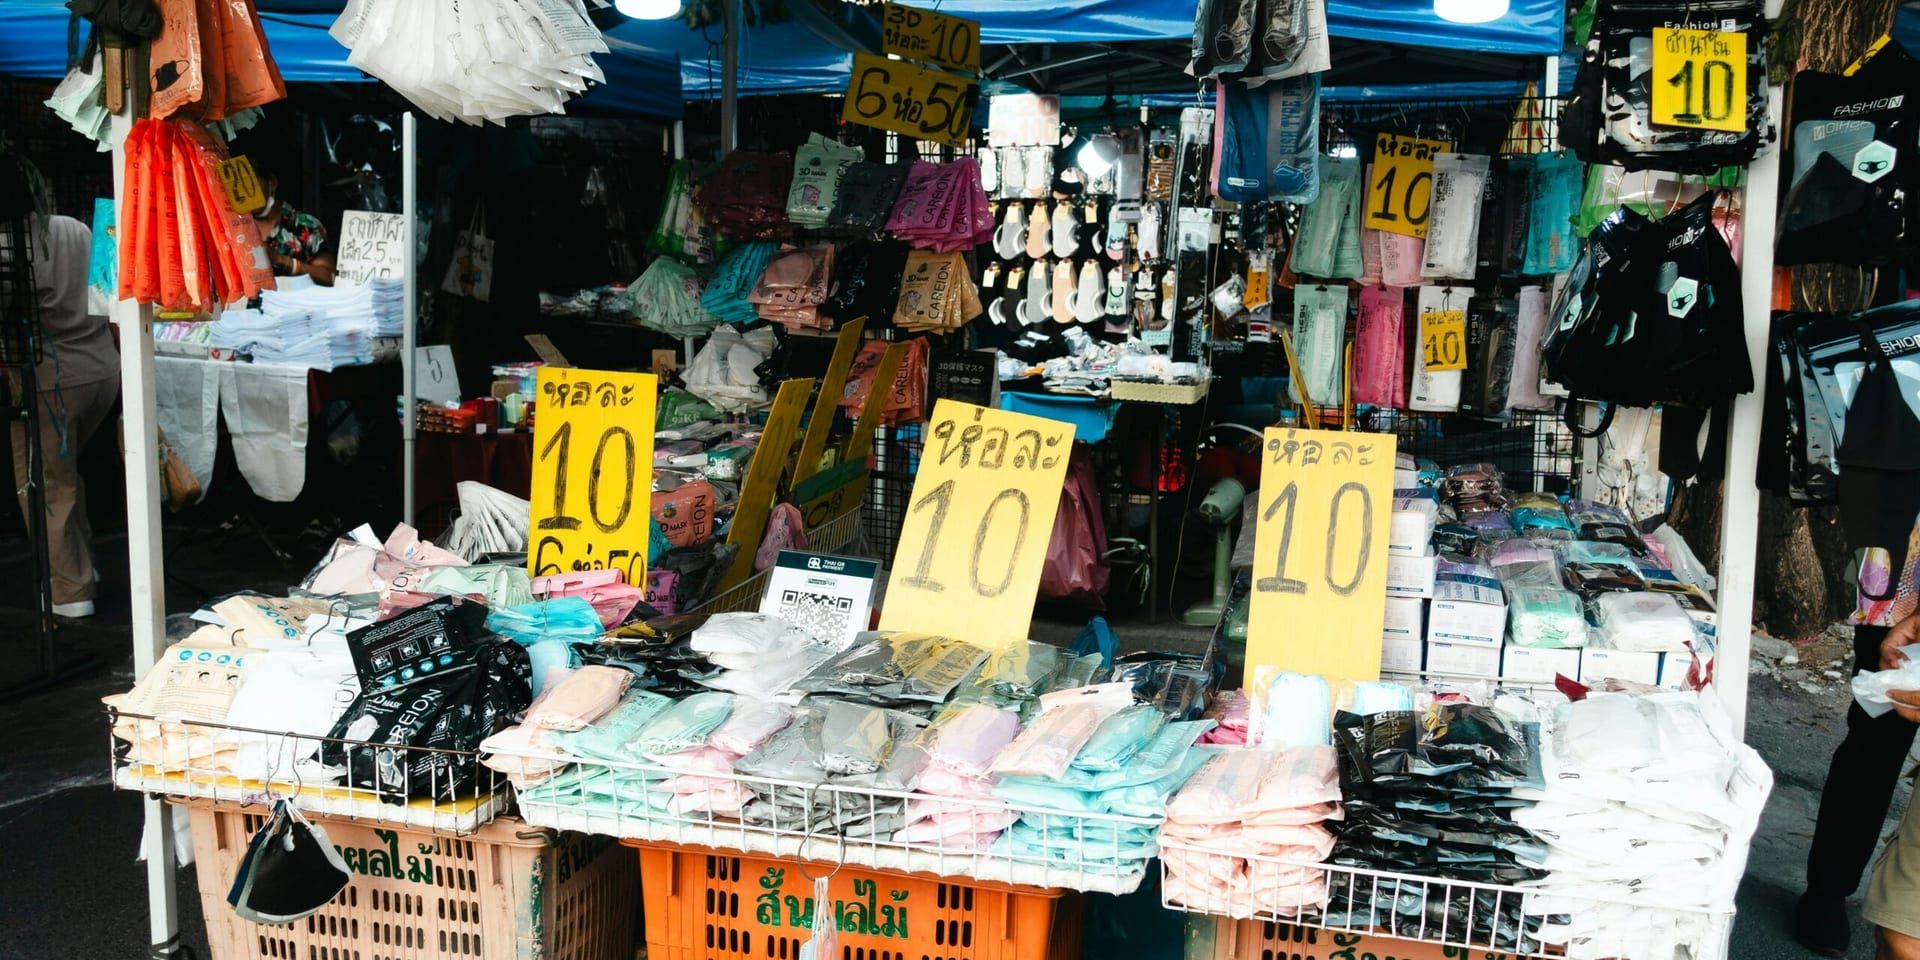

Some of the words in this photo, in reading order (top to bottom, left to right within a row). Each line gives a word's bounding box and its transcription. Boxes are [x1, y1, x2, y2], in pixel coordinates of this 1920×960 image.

[888, 6, 922, 28] 3D
[929, 17, 971, 66] 10
[855, 67, 891, 119] 6
[920, 82, 973, 139] 50
[1667, 60, 1734, 125] 10
[1833, 95, 1904, 116] FASHION
[223, 159, 255, 202] 20
[923, 172, 952, 224] CAREION
[1371, 166, 1432, 226] 10
[362, 241, 388, 263] 25
[928, 261, 951, 320] CAREION
[1425, 331, 1460, 366] 10
[1879, 335, 1920, 354] SHIO
[543, 370, 635, 409] ห่อละ
[935, 408, 1063, 472] ห่อละ
[1267, 428, 1375, 467] ห่อละ
[538, 421, 635, 534] 10
[900, 479, 1031, 598] 10
[1257, 480, 1373, 598] 10
[333, 828, 434, 885] ผลไม้
